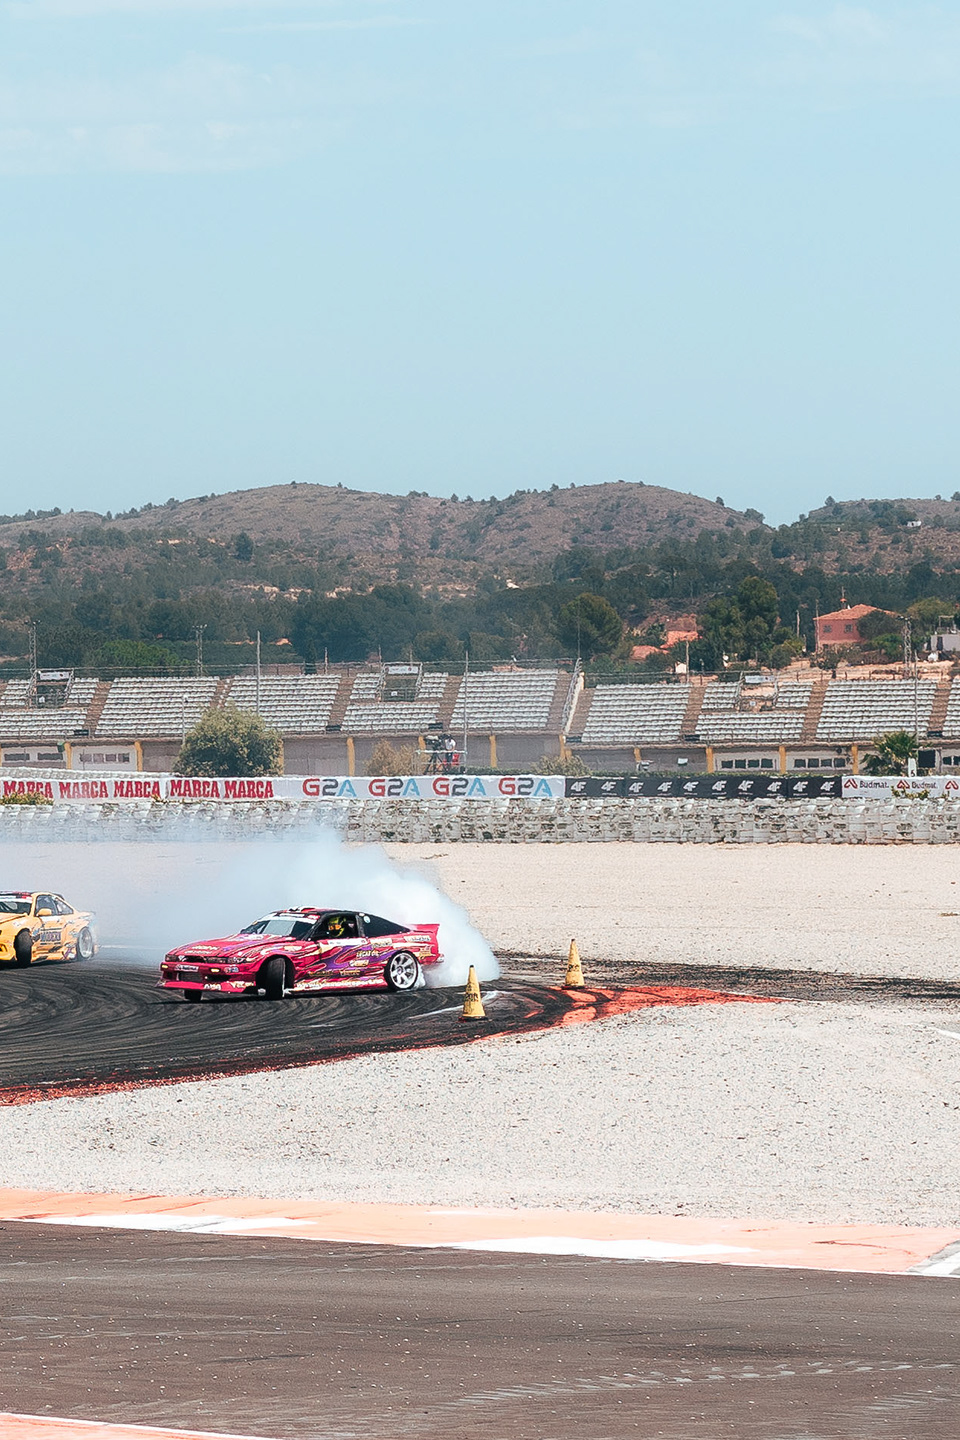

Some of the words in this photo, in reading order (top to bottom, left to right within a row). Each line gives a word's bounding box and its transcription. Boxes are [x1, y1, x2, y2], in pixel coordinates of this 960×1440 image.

[60, 781, 108, 798] MARCA
[114, 780, 160, 798] MARCA
[170, 780, 219, 798] MARCA
[224, 780, 274, 798] MARCA
[302, 778, 357, 797] G2A
[368, 778, 420, 796] G2A
[432, 777, 486, 796] G2A
[498, 777, 553, 797] G2A
[570, 781, 586, 791] 4F
[601, 781, 616, 791] 4F
[628, 782, 644, 792] 4F
[657, 781, 672, 792] 4F
[683, 781, 699, 791] 4F
[711, 780, 727, 791] 4F
[738, 780, 754, 791] 4F
[767, 781, 781, 792] 4F
[793, 781, 808, 792] 4F
[820, 781, 835, 791] 4F
